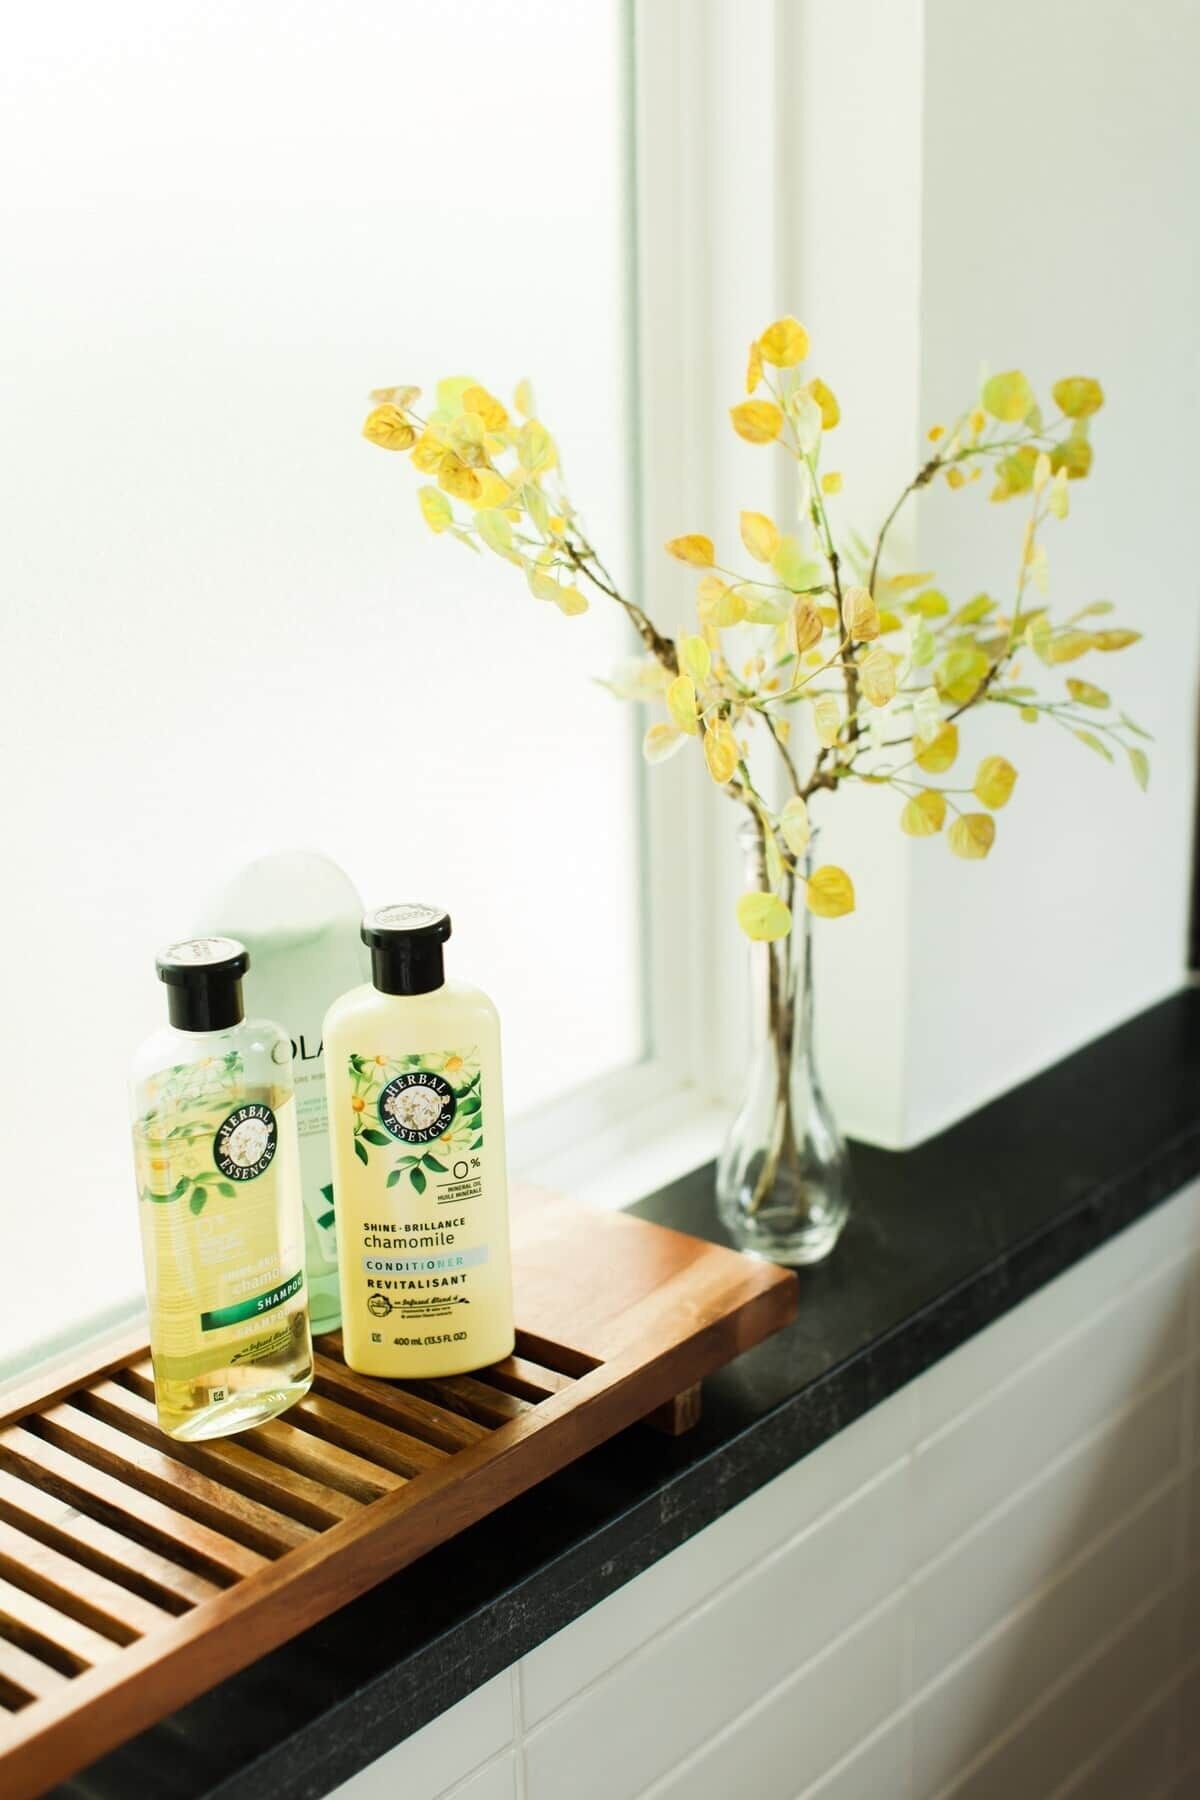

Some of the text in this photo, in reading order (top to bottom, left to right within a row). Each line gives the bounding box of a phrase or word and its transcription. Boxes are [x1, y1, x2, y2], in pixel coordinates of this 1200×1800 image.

[386, 1074, 446, 1098] HERBAL
[219, 1105, 270, 1138] HERBAL
[385, 1113, 452, 1142] ESSENCES
[219, 1142, 275, 1179] ESSENCES
[448, 1181, 472, 1192] MINERAL
[364, 1232, 455, 1249] chamomile
[366, 1256, 464, 1271] CONDITIONER
[367, 1274, 467, 1289] REVITALISANT
[394, 1337, 409, 1345] 400
